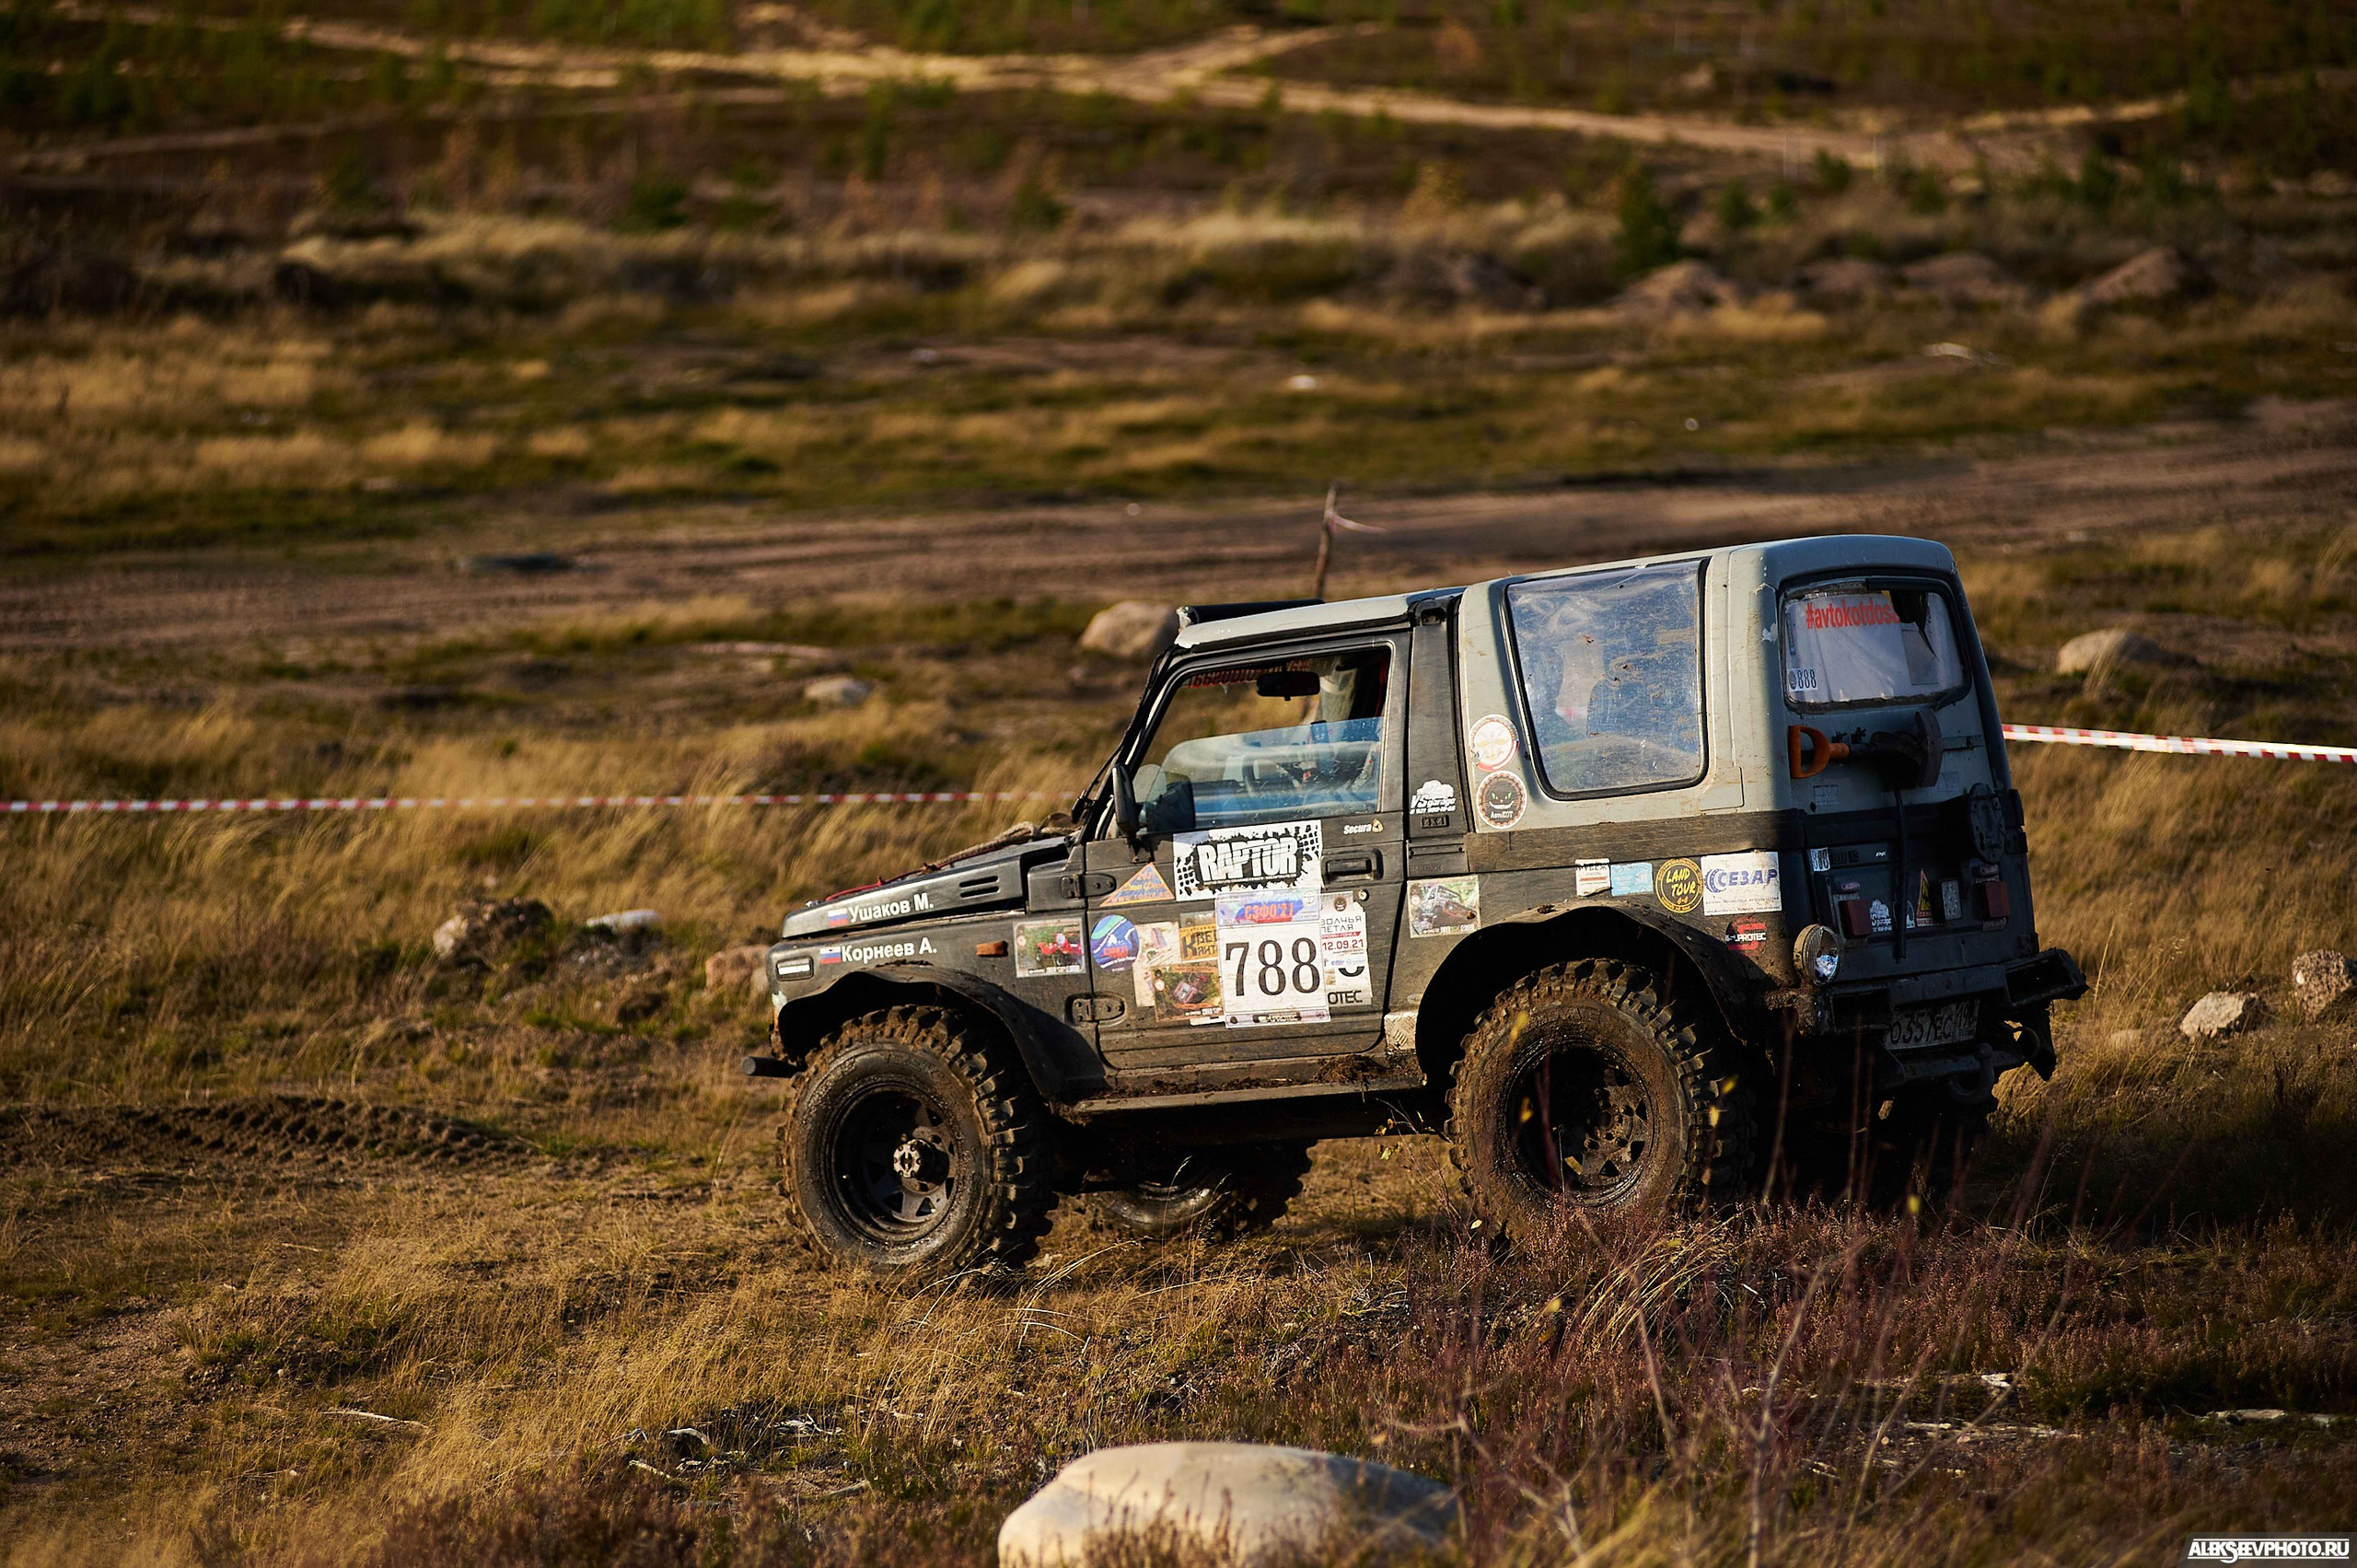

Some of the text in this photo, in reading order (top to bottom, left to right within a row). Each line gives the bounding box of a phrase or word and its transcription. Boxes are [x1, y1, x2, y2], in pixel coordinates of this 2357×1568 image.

[1411, 795, 1429, 809] VS
[1343, 823, 1372, 835] Secura
[1196, 836, 1299, 882] RAPTOR
[1666, 866, 1690, 884] LAND
[1717, 868, 1778, 887] СЕЗАР
[1671, 880, 1696, 897] TOUR
[847, 892, 935, 923] Ушаков М.
[841, 936, 937, 964] Корнеев А.
[1322, 938, 1364, 951] 12.09.21
[1225, 937, 1320, 997] 788
